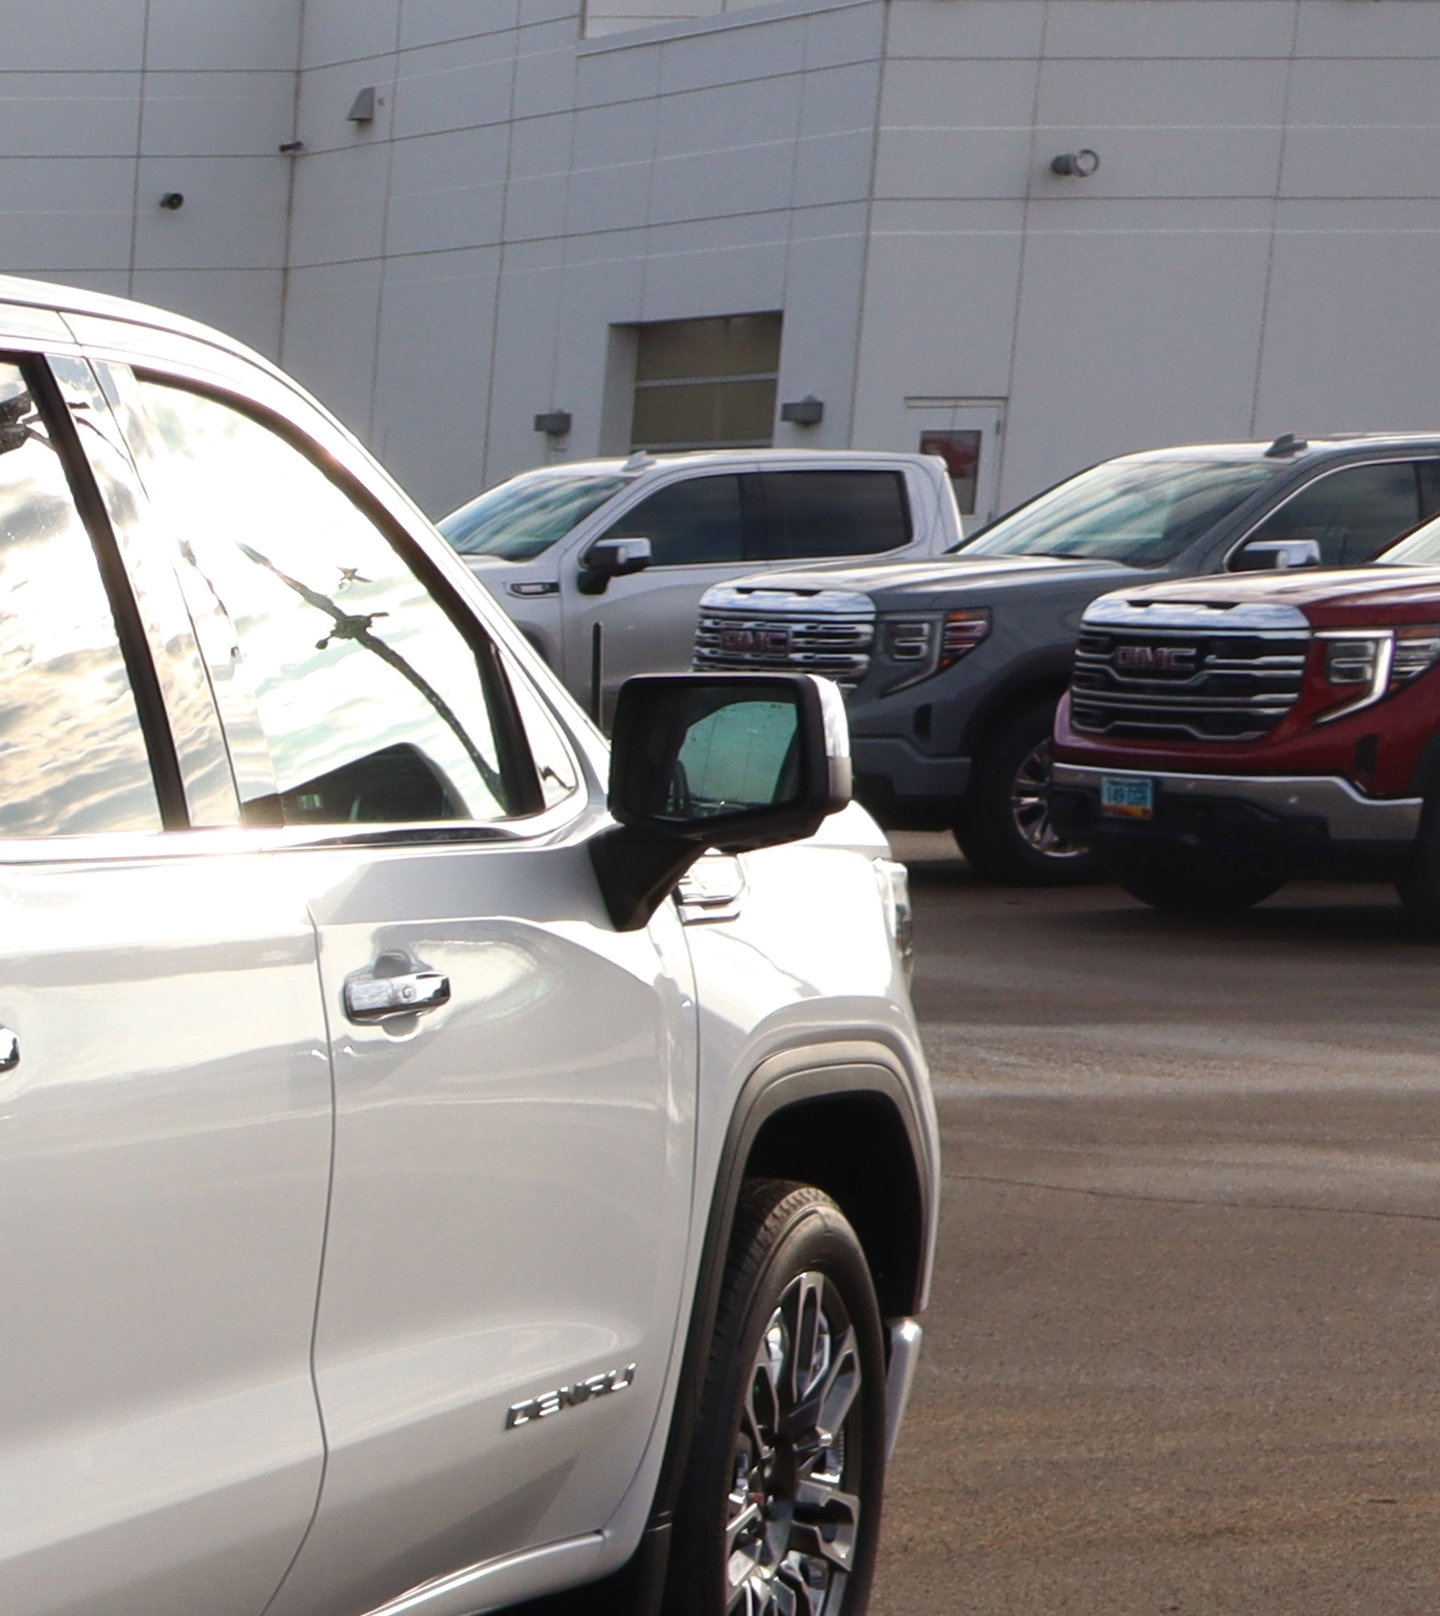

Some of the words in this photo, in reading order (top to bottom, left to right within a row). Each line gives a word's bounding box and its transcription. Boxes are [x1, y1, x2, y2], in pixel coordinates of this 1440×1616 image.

[722, 630, 787, 652] GMC
[1115, 646, 1197, 671] GMC
[504, 1362, 637, 1431] DENALI
